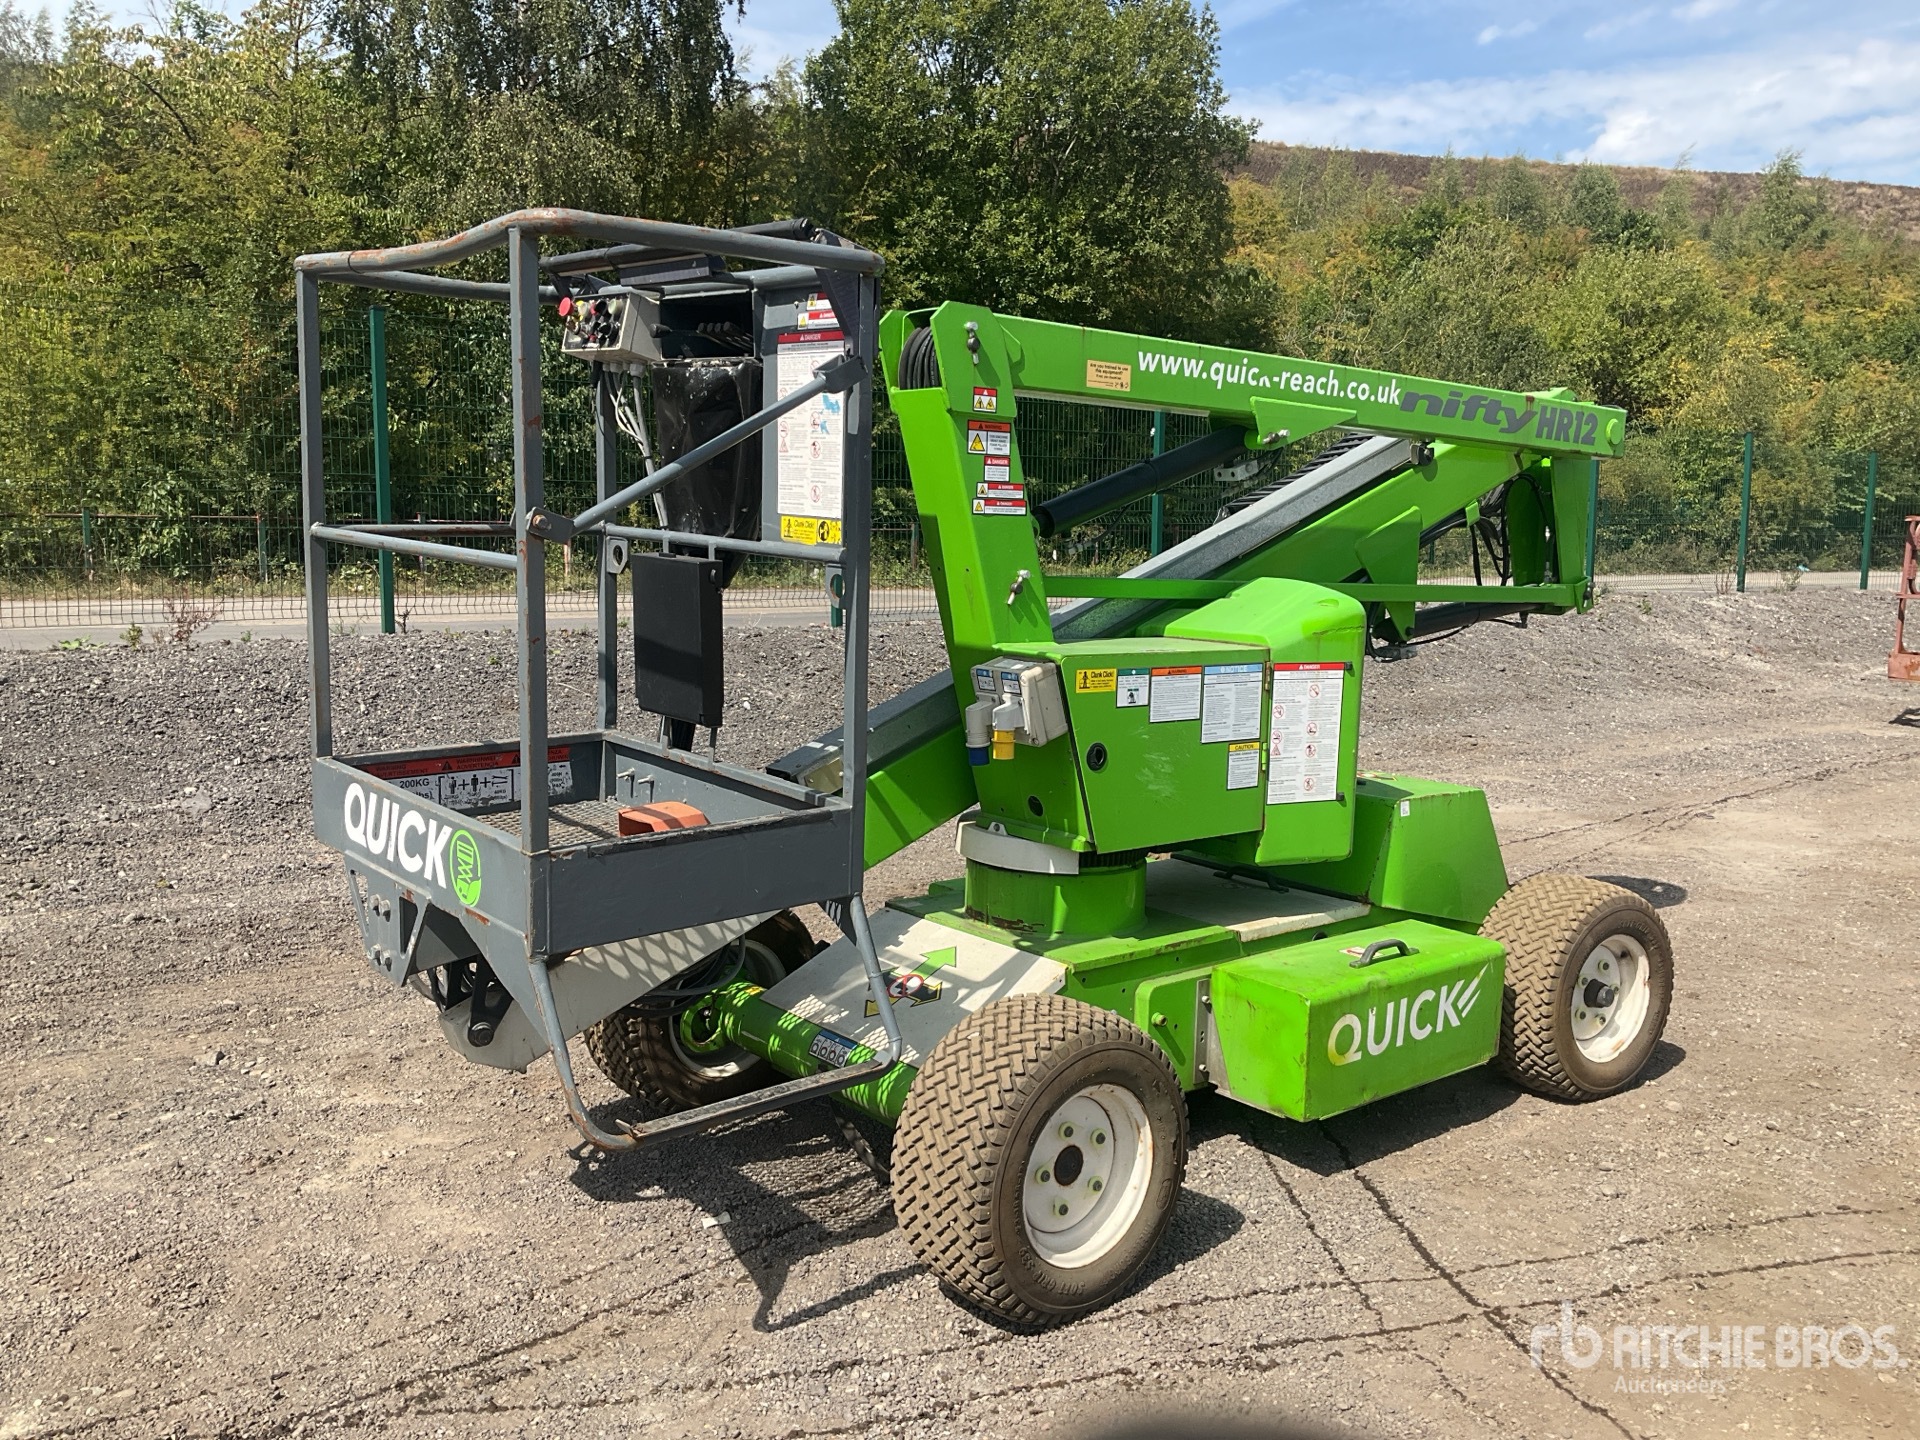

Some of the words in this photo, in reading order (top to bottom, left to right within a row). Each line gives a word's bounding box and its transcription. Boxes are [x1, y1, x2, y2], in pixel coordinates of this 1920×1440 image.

[1400, 391, 1537, 434] nifty
[1535, 406, 1599, 446] HR12
[1091, 671, 1102, 679] Clunk
[1225, 665, 1248, 673] NOTICE
[400, 778, 430, 788] 200KG
[344, 783, 452, 889] QUICK
[1328, 979, 1465, 1067] QUICK
